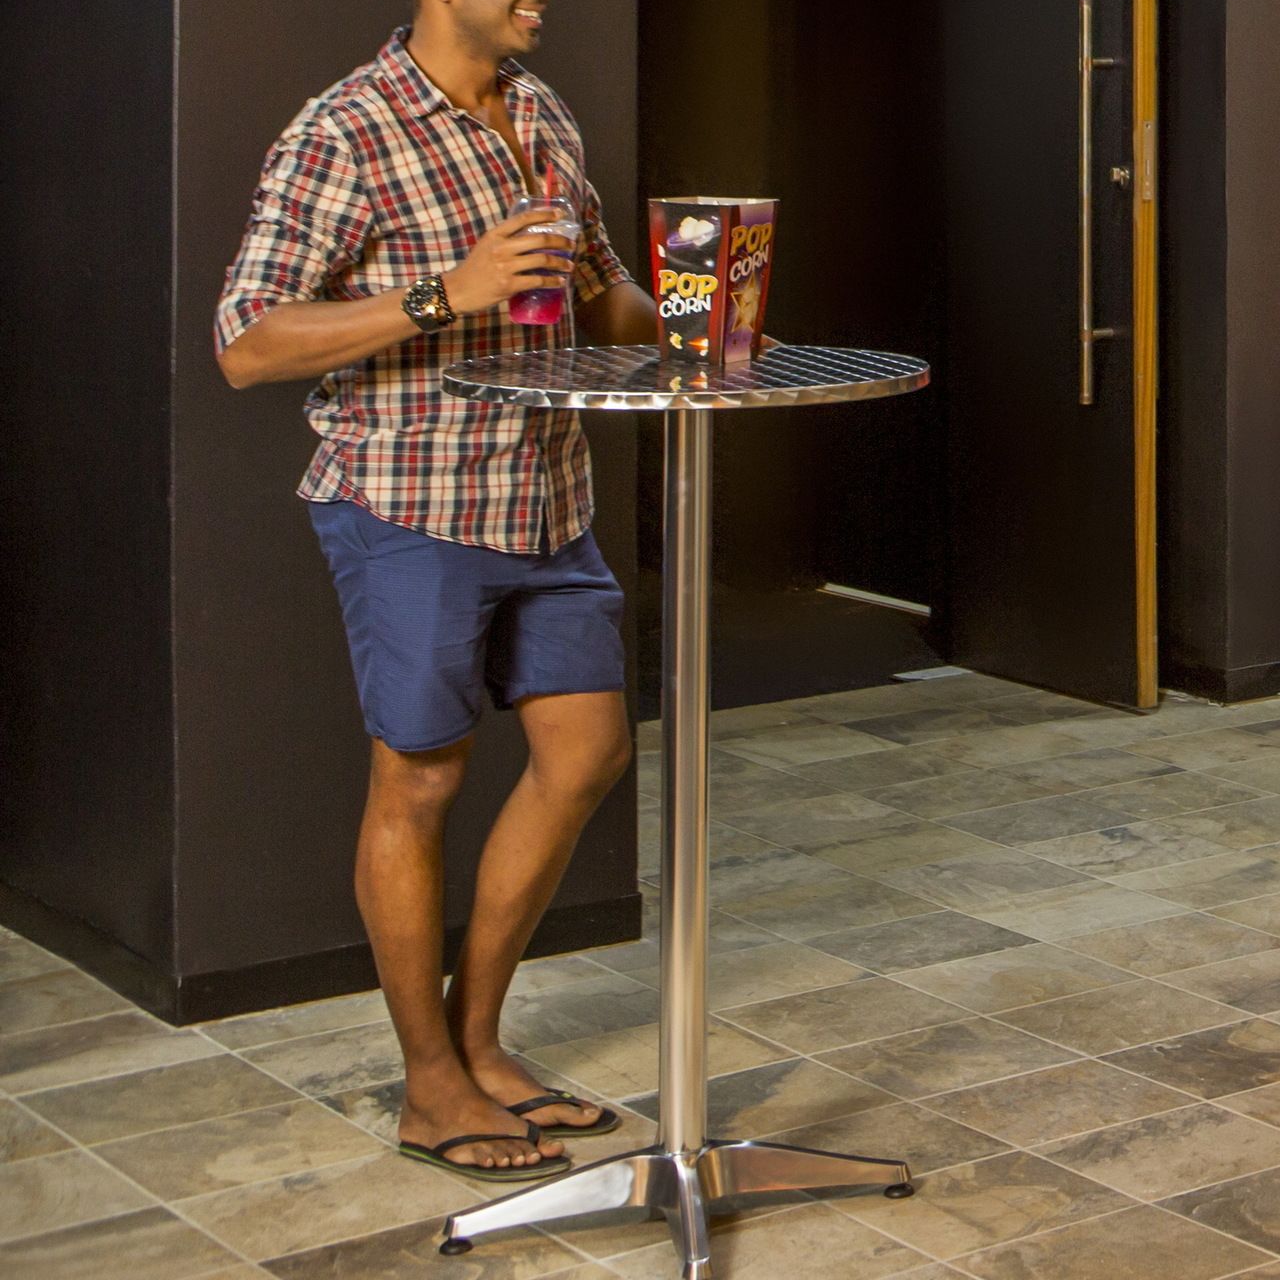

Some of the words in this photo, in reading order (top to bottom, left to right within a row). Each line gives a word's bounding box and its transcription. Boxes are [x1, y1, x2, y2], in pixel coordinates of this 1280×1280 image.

[730, 223, 774, 257] POP
[729, 245, 769, 283] CORN
[658, 269, 719, 300] POP
[659, 294, 712, 319] CORN
